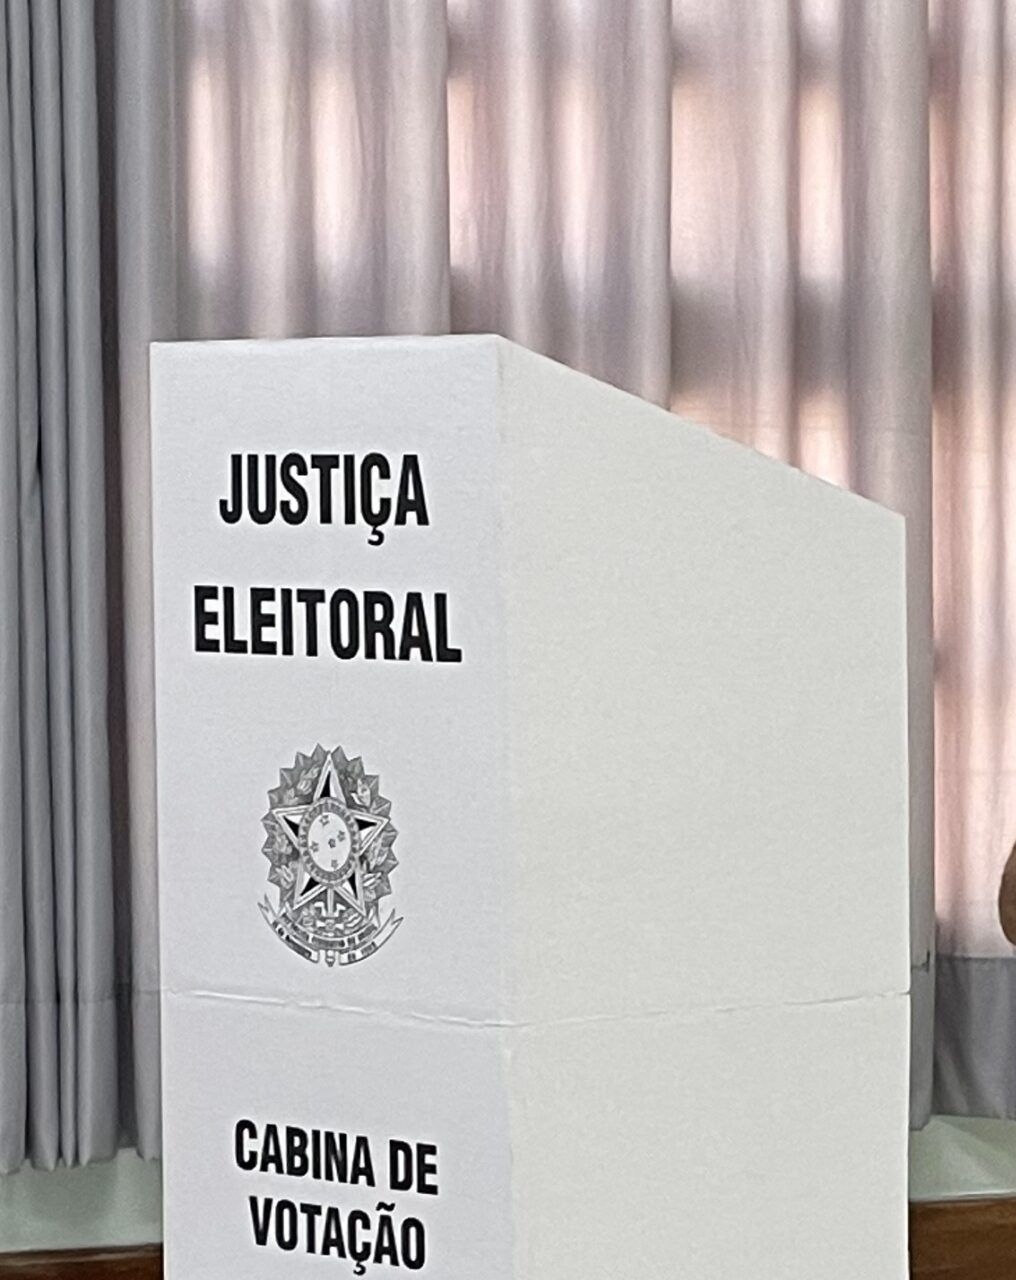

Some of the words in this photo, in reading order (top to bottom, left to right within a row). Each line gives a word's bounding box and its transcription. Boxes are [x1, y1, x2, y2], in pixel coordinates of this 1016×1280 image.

[219, 452, 430, 546] JUSTIÇA
[194, 585, 462, 663] ELEITORAL
[235, 1119, 376, 1188] CABINA
[389, 1139, 439, 1195] DE
[249, 1195, 426, 1276] VOTAÇÃO
